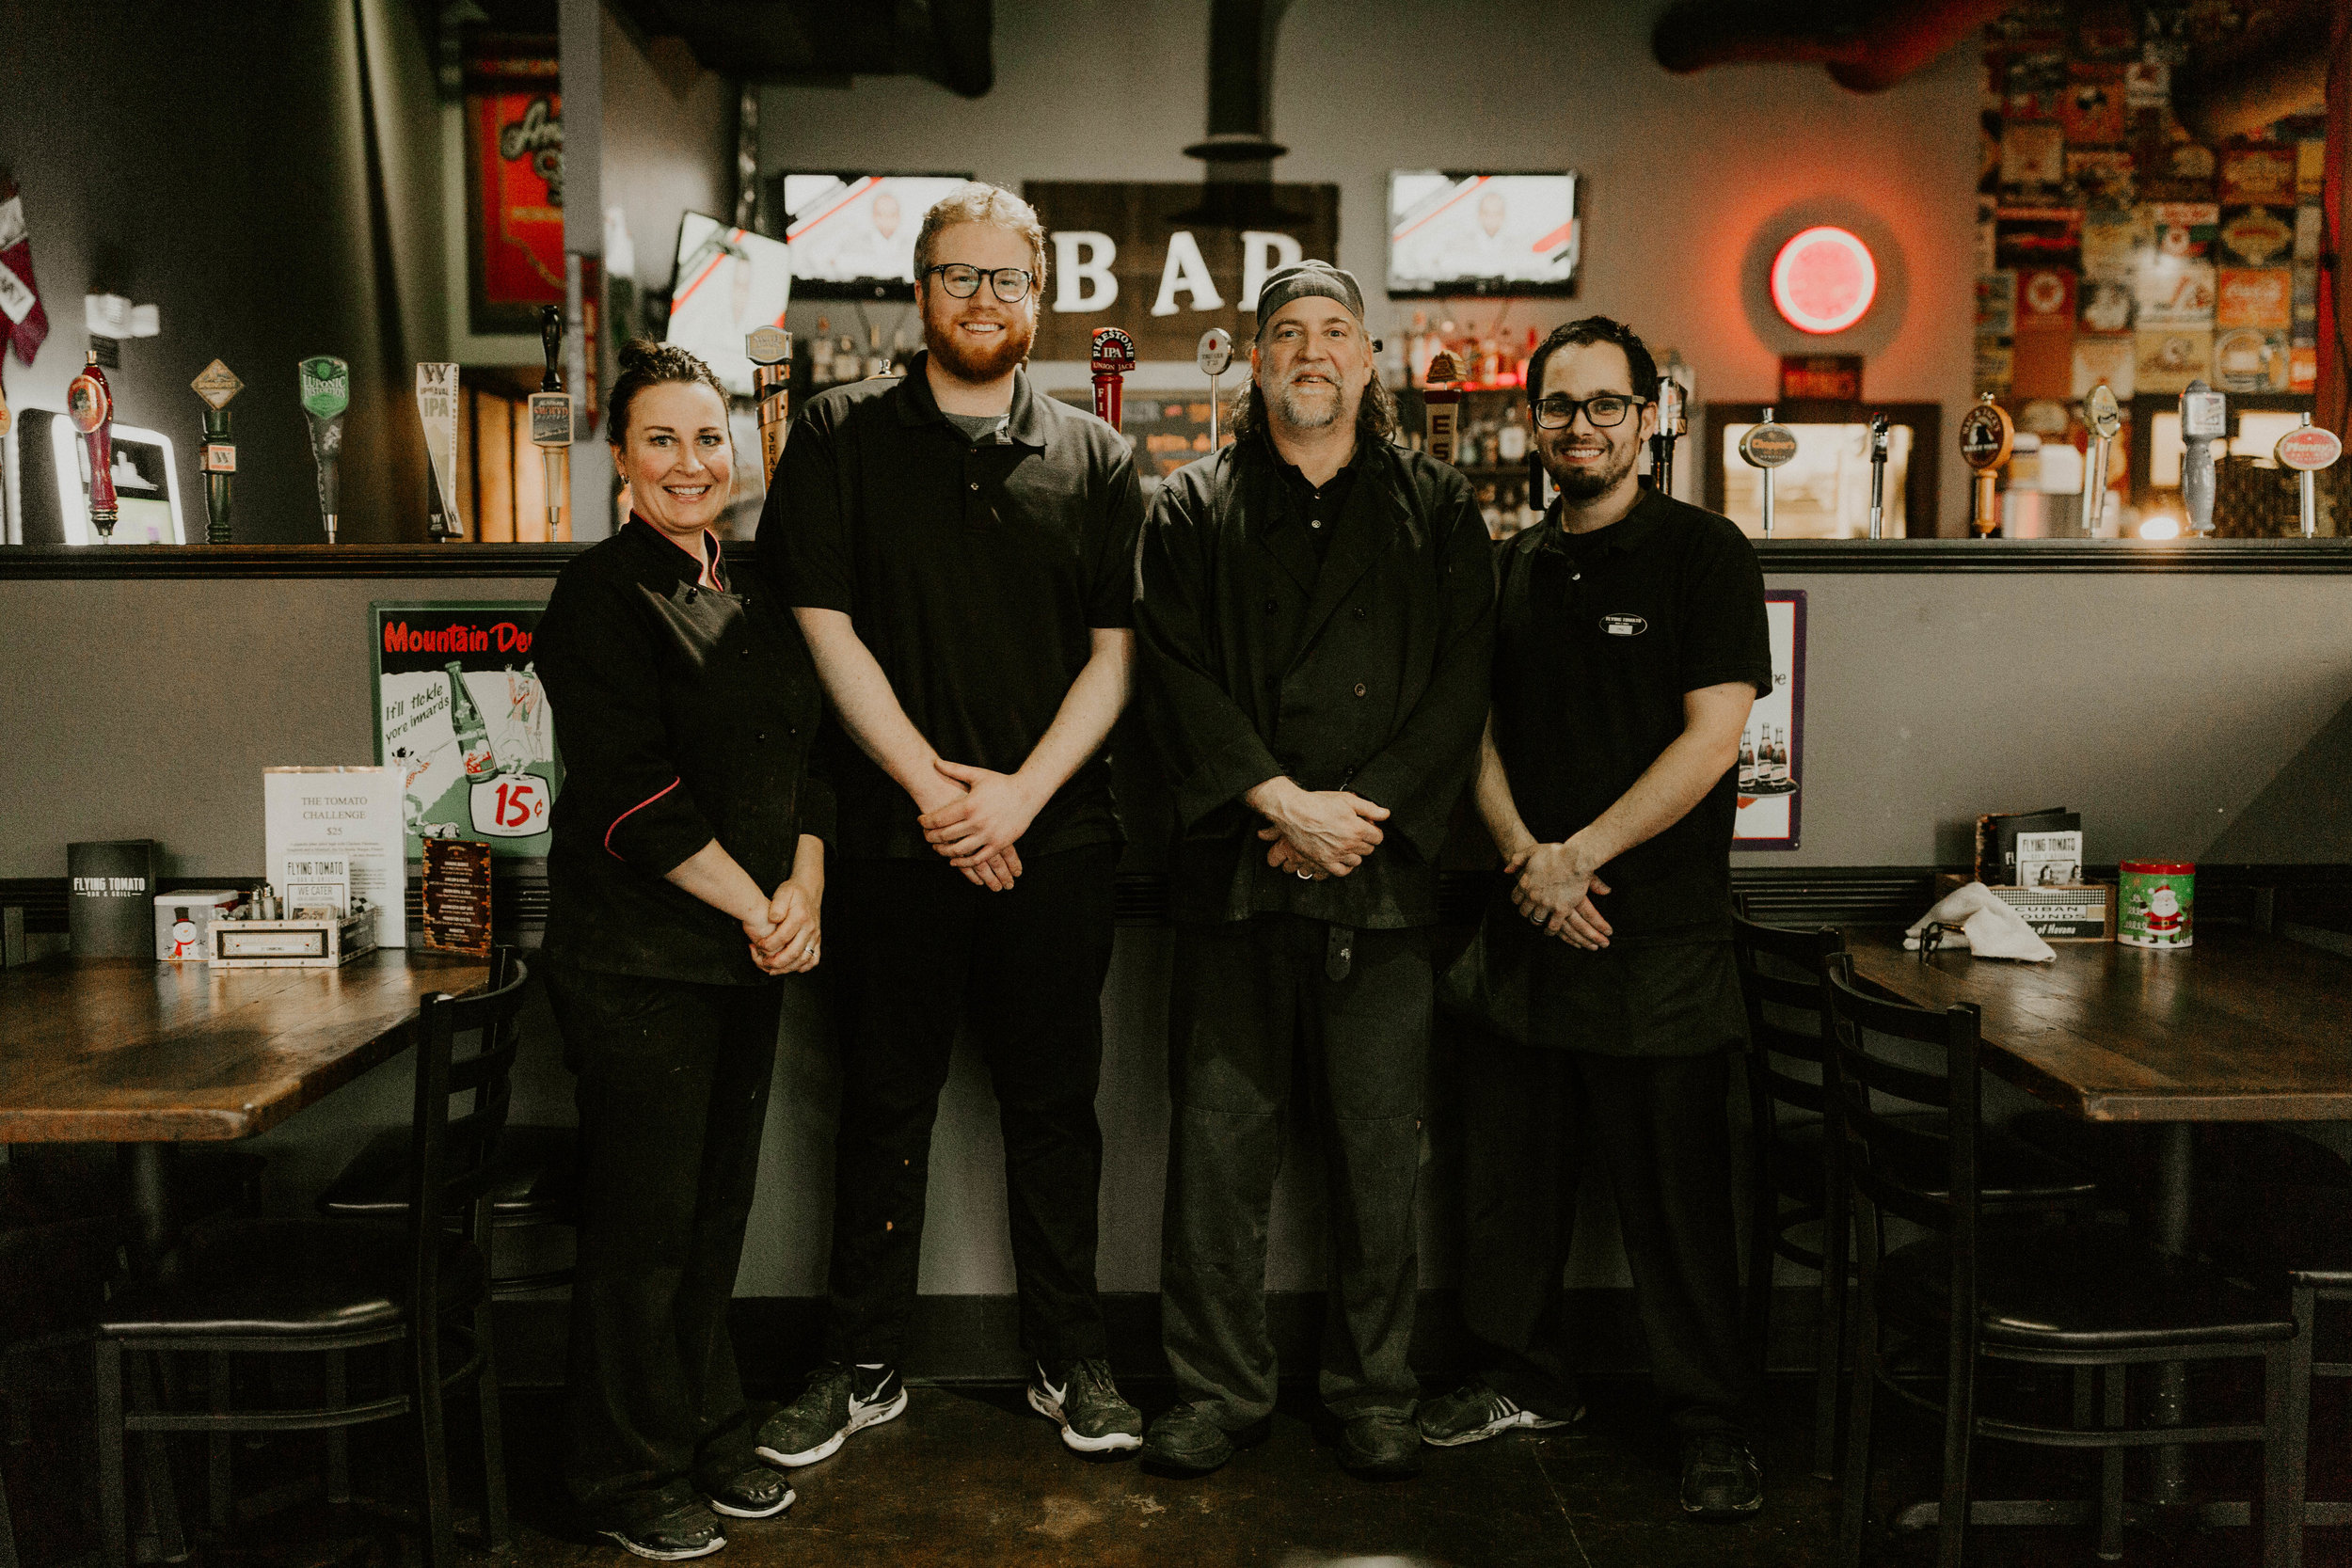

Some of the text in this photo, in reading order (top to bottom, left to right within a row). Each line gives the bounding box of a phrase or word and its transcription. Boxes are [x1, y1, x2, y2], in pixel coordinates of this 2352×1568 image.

[1092, 329, 1135, 358] FIRESTONE
[1104, 346, 1122, 358] IPA
[1092, 361, 1135, 372] UNION JACK
[302, 374, 346, 389] LUPONIC
[423, 398, 450, 418] IPA
[384, 622, 532, 653] Mountain De
[411, 681, 444, 710] tickle
[386, 694, 451, 745] yore innards
[301, 797, 369, 806] THE TOMATO
[302, 811, 367, 820] CHALLENGE
[326, 827, 343, 836] $25
[2023, 837, 2076, 852] FLYING TOMATO
[287, 862, 343, 876] FLYING TOMATO
[73, 877, 146, 892] FLYING TOMATO
[297, 886, 333, 895] WE CATER
[2037, 923, 2076, 935] of Havana
